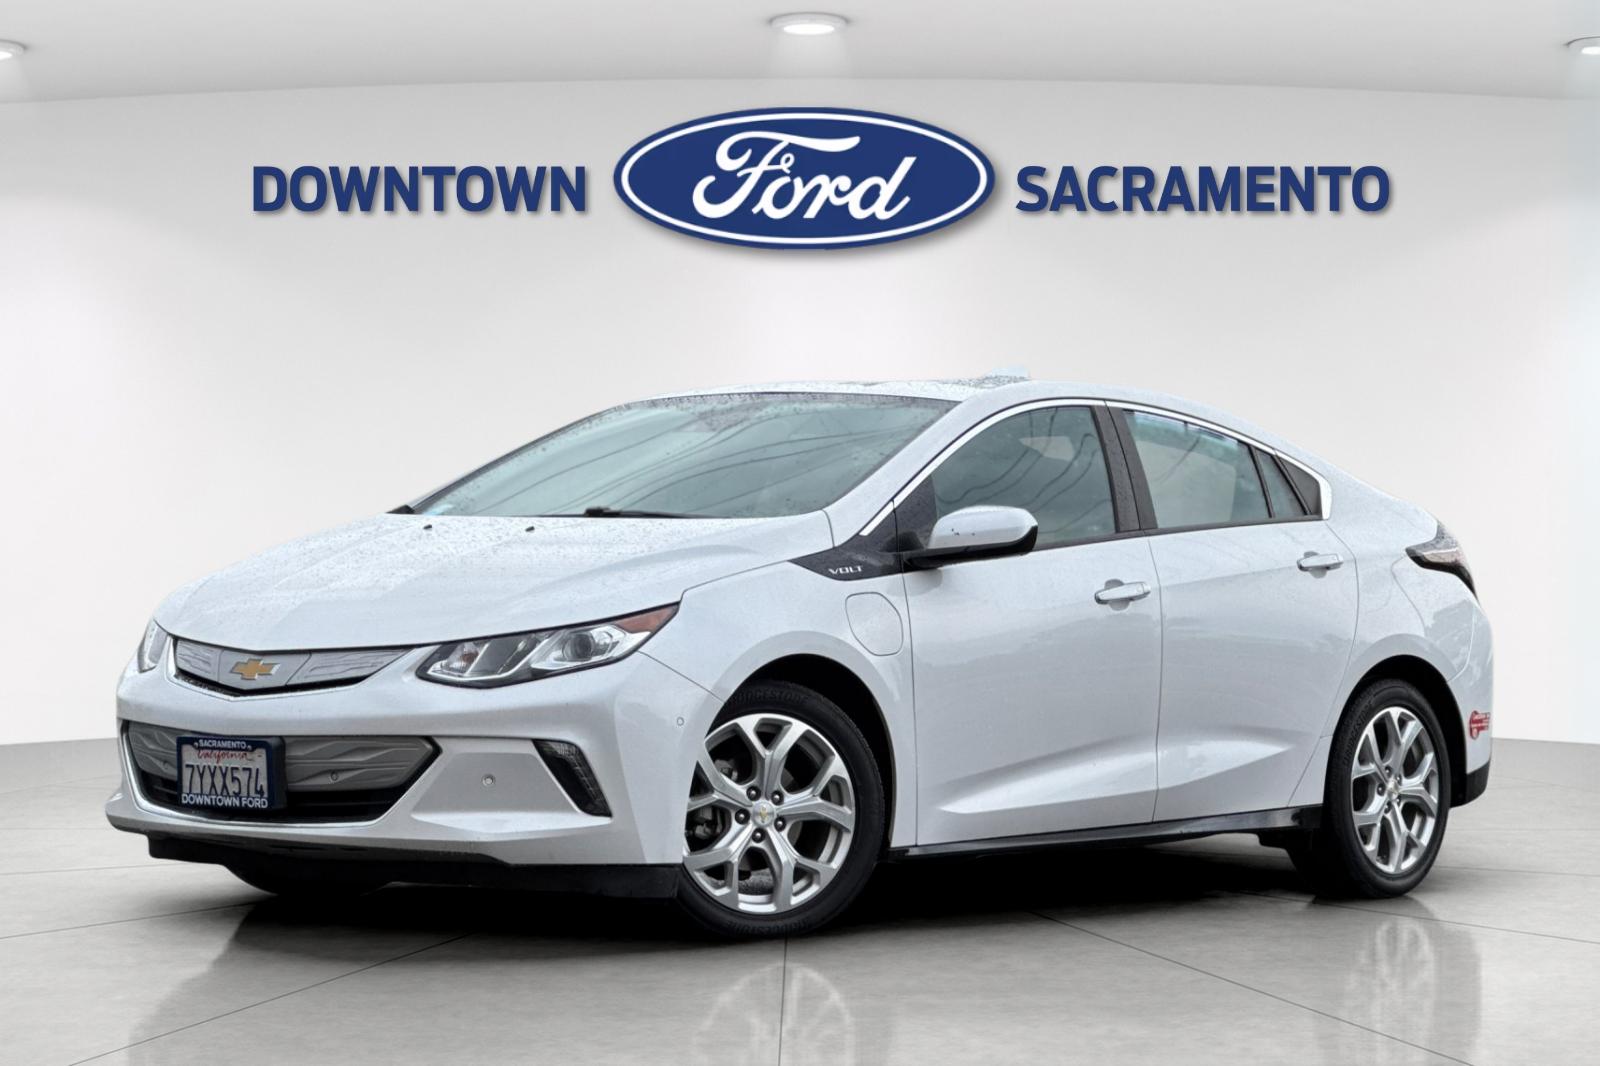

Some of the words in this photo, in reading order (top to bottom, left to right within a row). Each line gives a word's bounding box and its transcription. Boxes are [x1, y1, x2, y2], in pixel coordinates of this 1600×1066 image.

[253, 165, 585, 212] DOWNTOWN
[693, 131, 917, 220] Ford
[1016, 165, 1390, 212] SACRAMENTO
[828, 565, 863, 574] VOLT
[198, 739, 247, 748] SACRAMENTO
[198, 750, 248, 763] California
[185, 764, 264, 797] 7YXX574
[182, 794, 240, 806] DOWNTOWN
[241, 797, 268, 808] FORD
